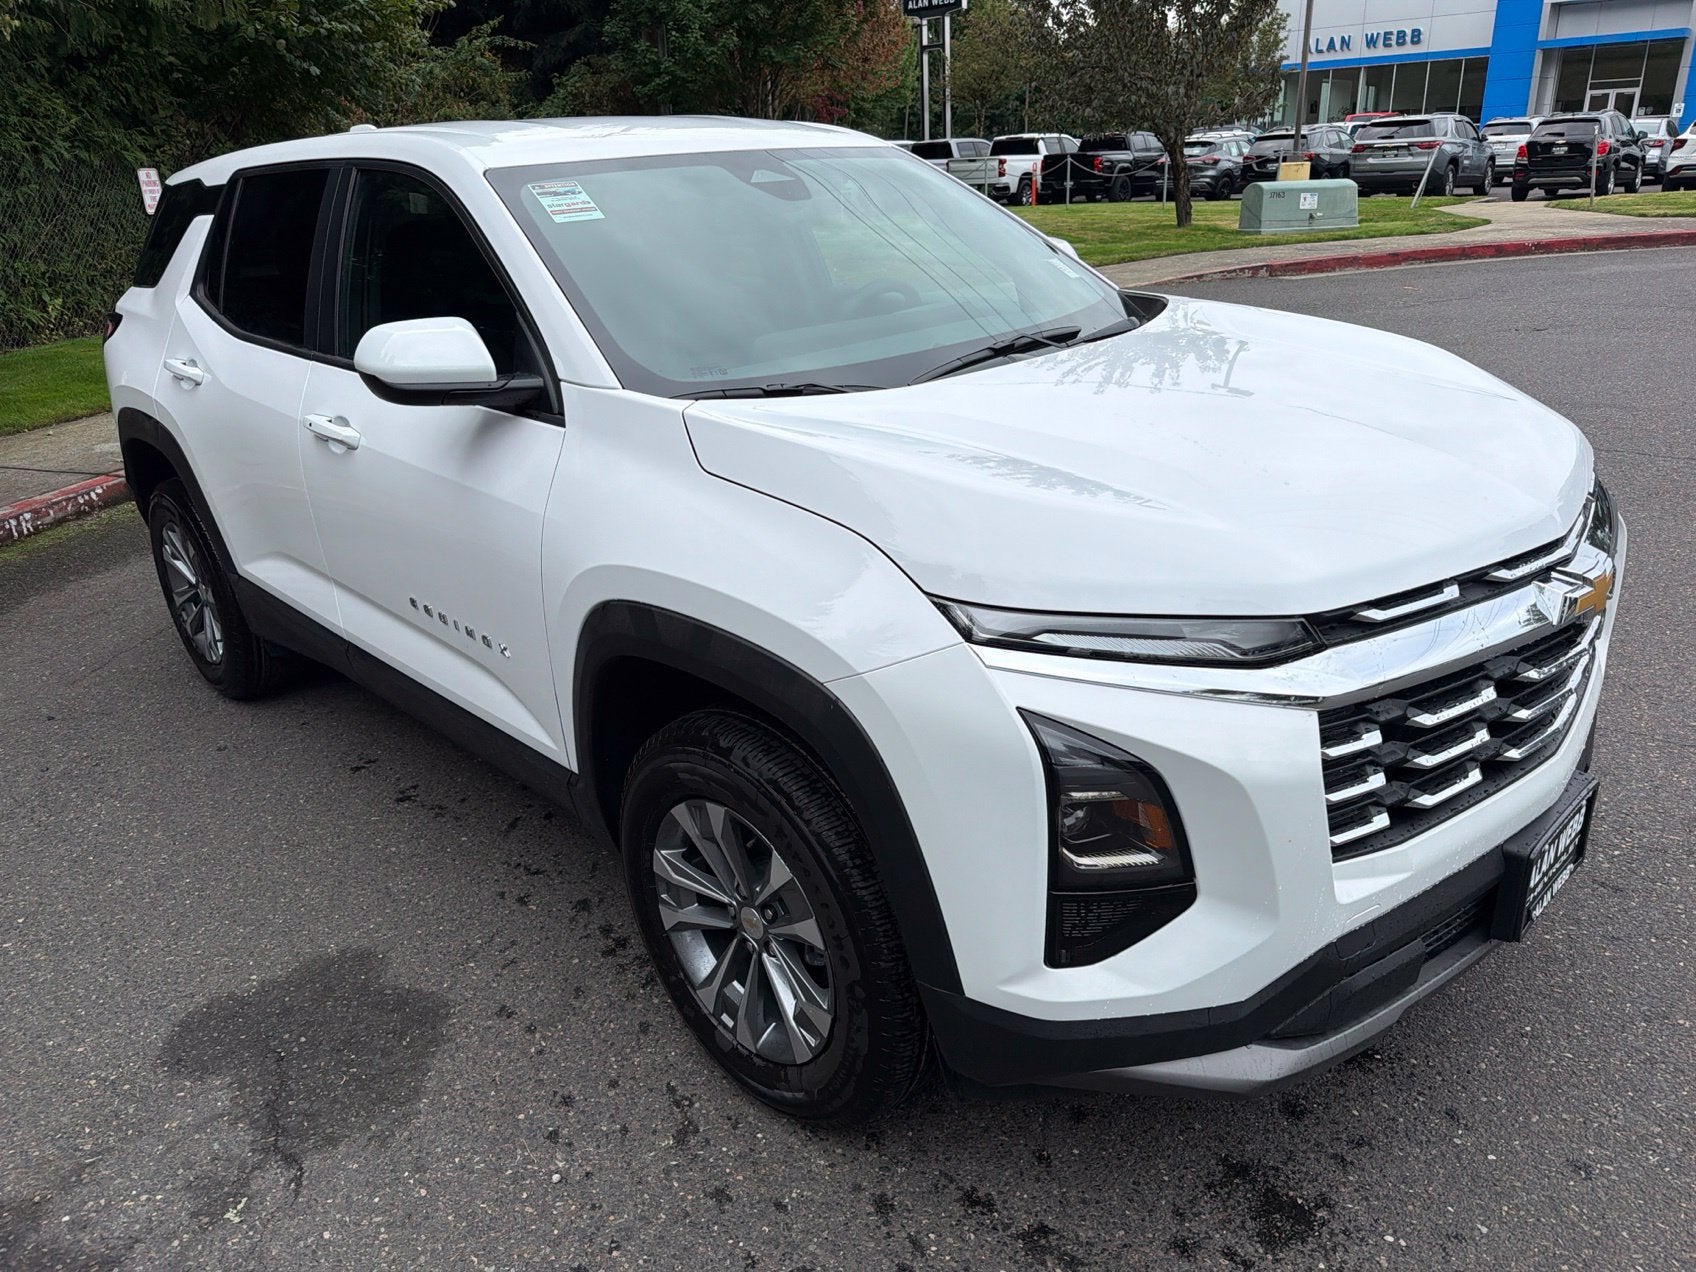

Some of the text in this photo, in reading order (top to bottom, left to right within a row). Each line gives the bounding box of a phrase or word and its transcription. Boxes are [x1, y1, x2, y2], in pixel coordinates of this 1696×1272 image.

[908, 0, 928, 9] ALAN
[1365, 28, 1422, 49] WEBB
[409, 596, 512, 659] EQUINOX
